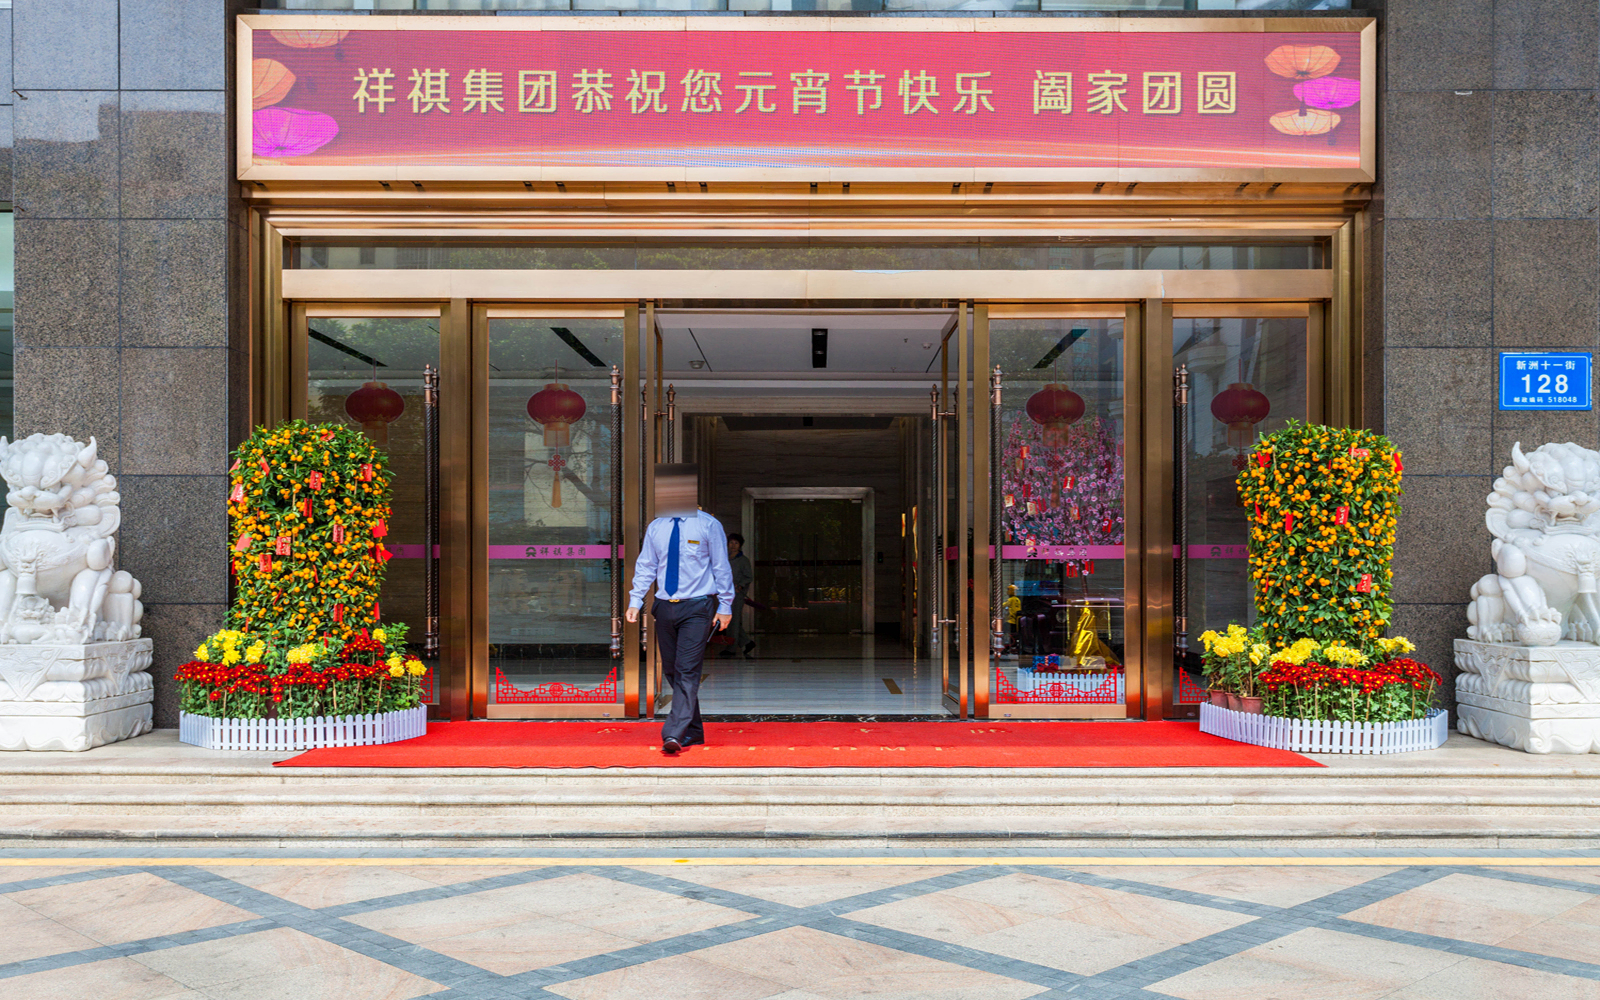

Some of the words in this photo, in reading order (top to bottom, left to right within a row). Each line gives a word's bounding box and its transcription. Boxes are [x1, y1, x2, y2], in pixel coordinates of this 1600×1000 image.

[352, 67, 995, 115] 祥祺集团恭祝您元宵节快乐
[1033, 69, 1237, 115] 阖家团圆
[1516, 360, 1576, 370] 新洲十一街
[1521, 373, 1569, 394] 128
